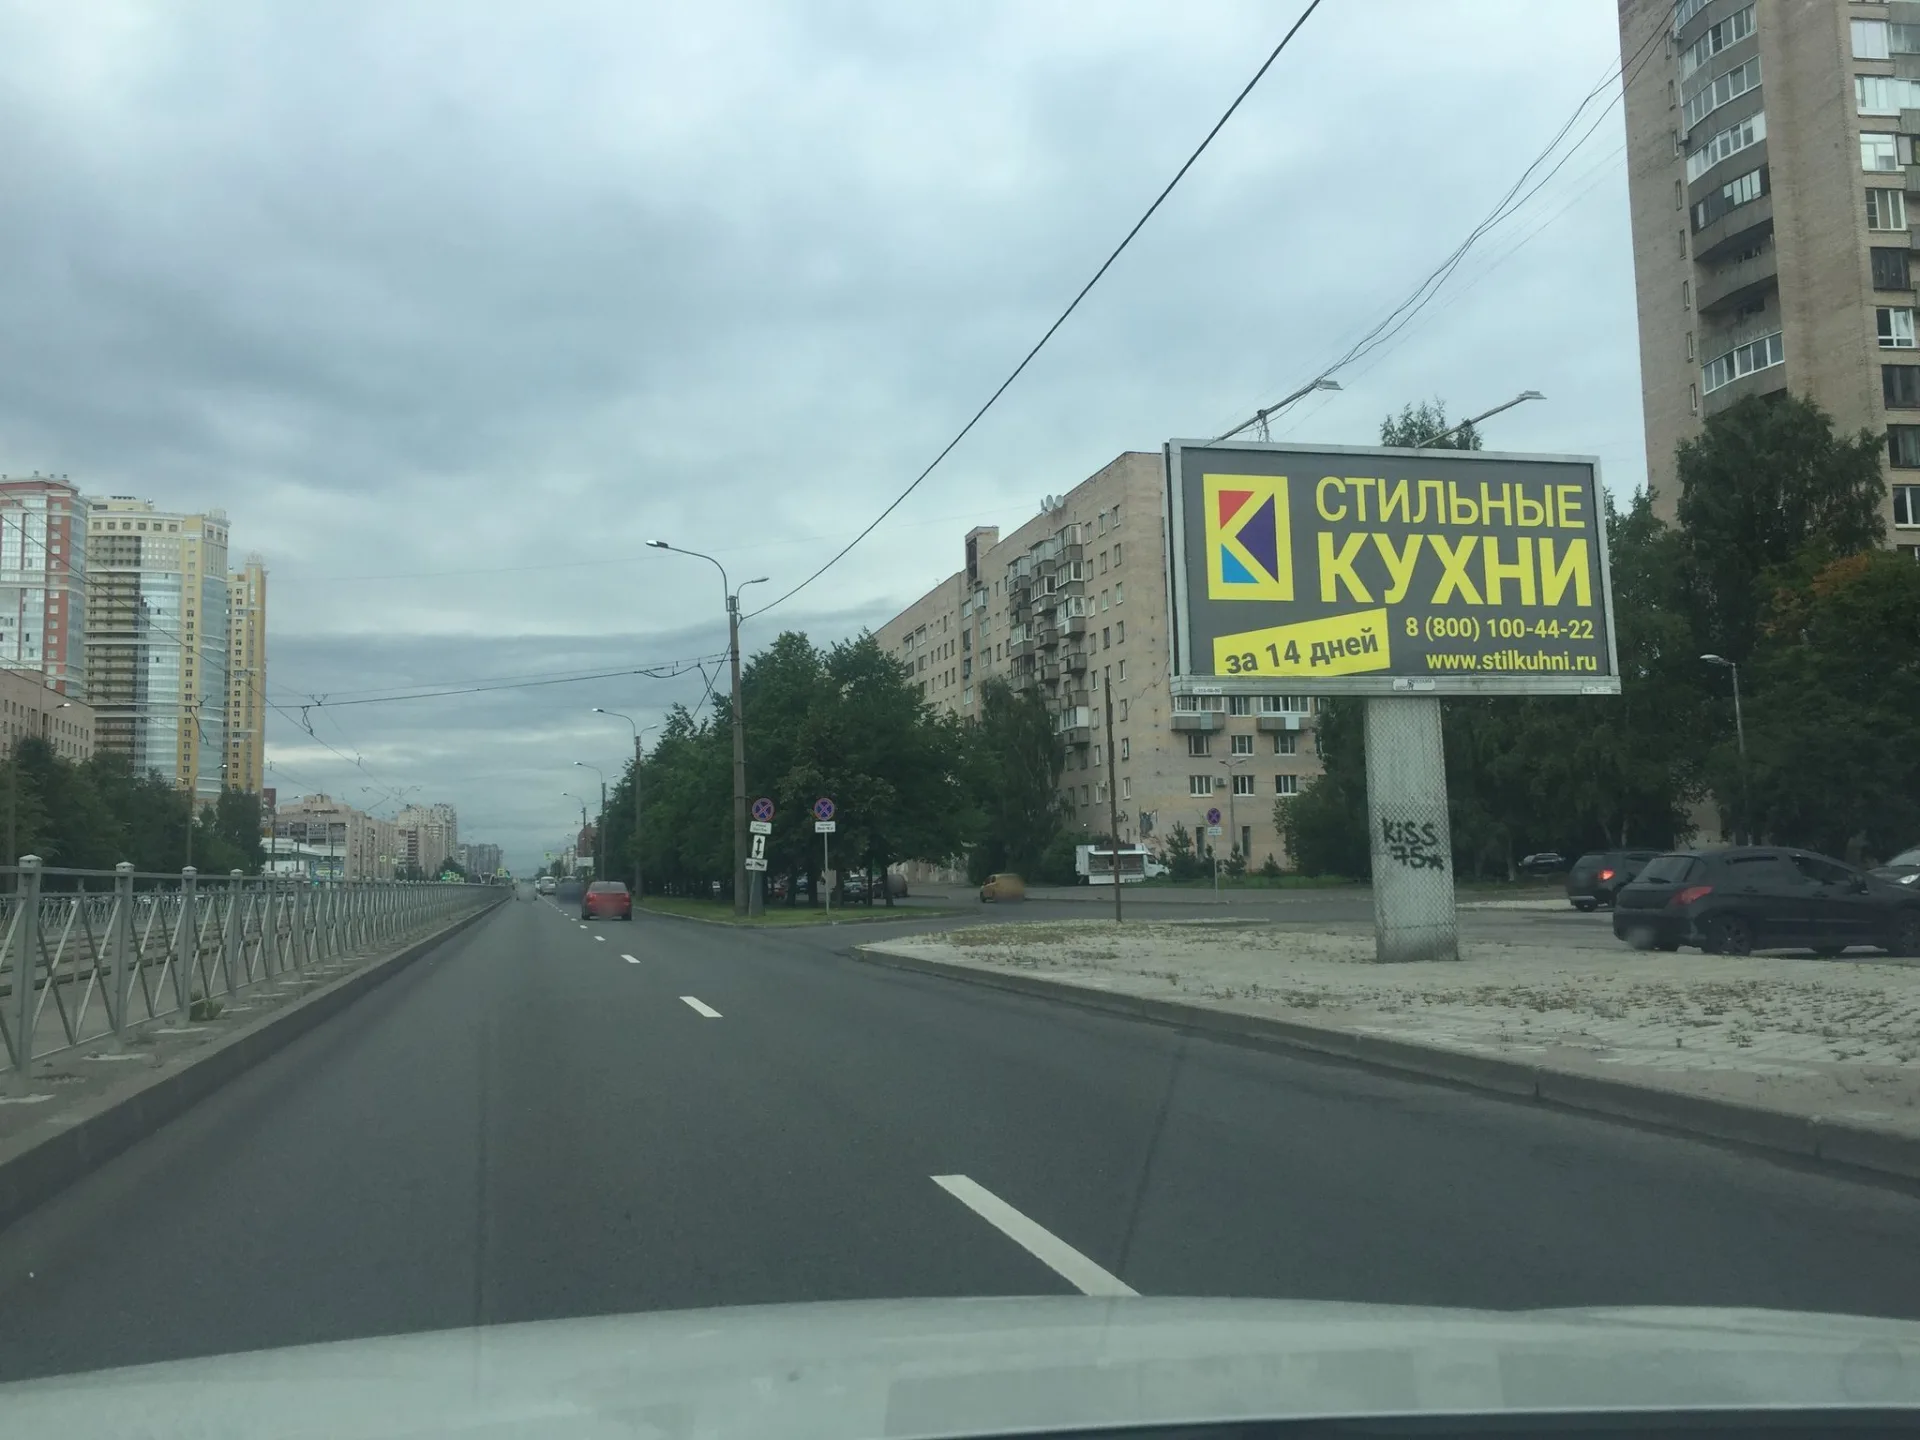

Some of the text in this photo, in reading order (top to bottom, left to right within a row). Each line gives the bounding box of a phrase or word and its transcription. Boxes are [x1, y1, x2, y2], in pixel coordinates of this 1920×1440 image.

[1315, 476, 1585, 528] СТИЛЬНЫЕ
[1317, 532, 1592, 607] КУХНИ
[1225, 627, 1378, 674] за 14 дней
[1406, 616, 1594, 642] 8 (800) 100-44-22
[1426, 650, 1597, 671] www.stilkuhni.ru
